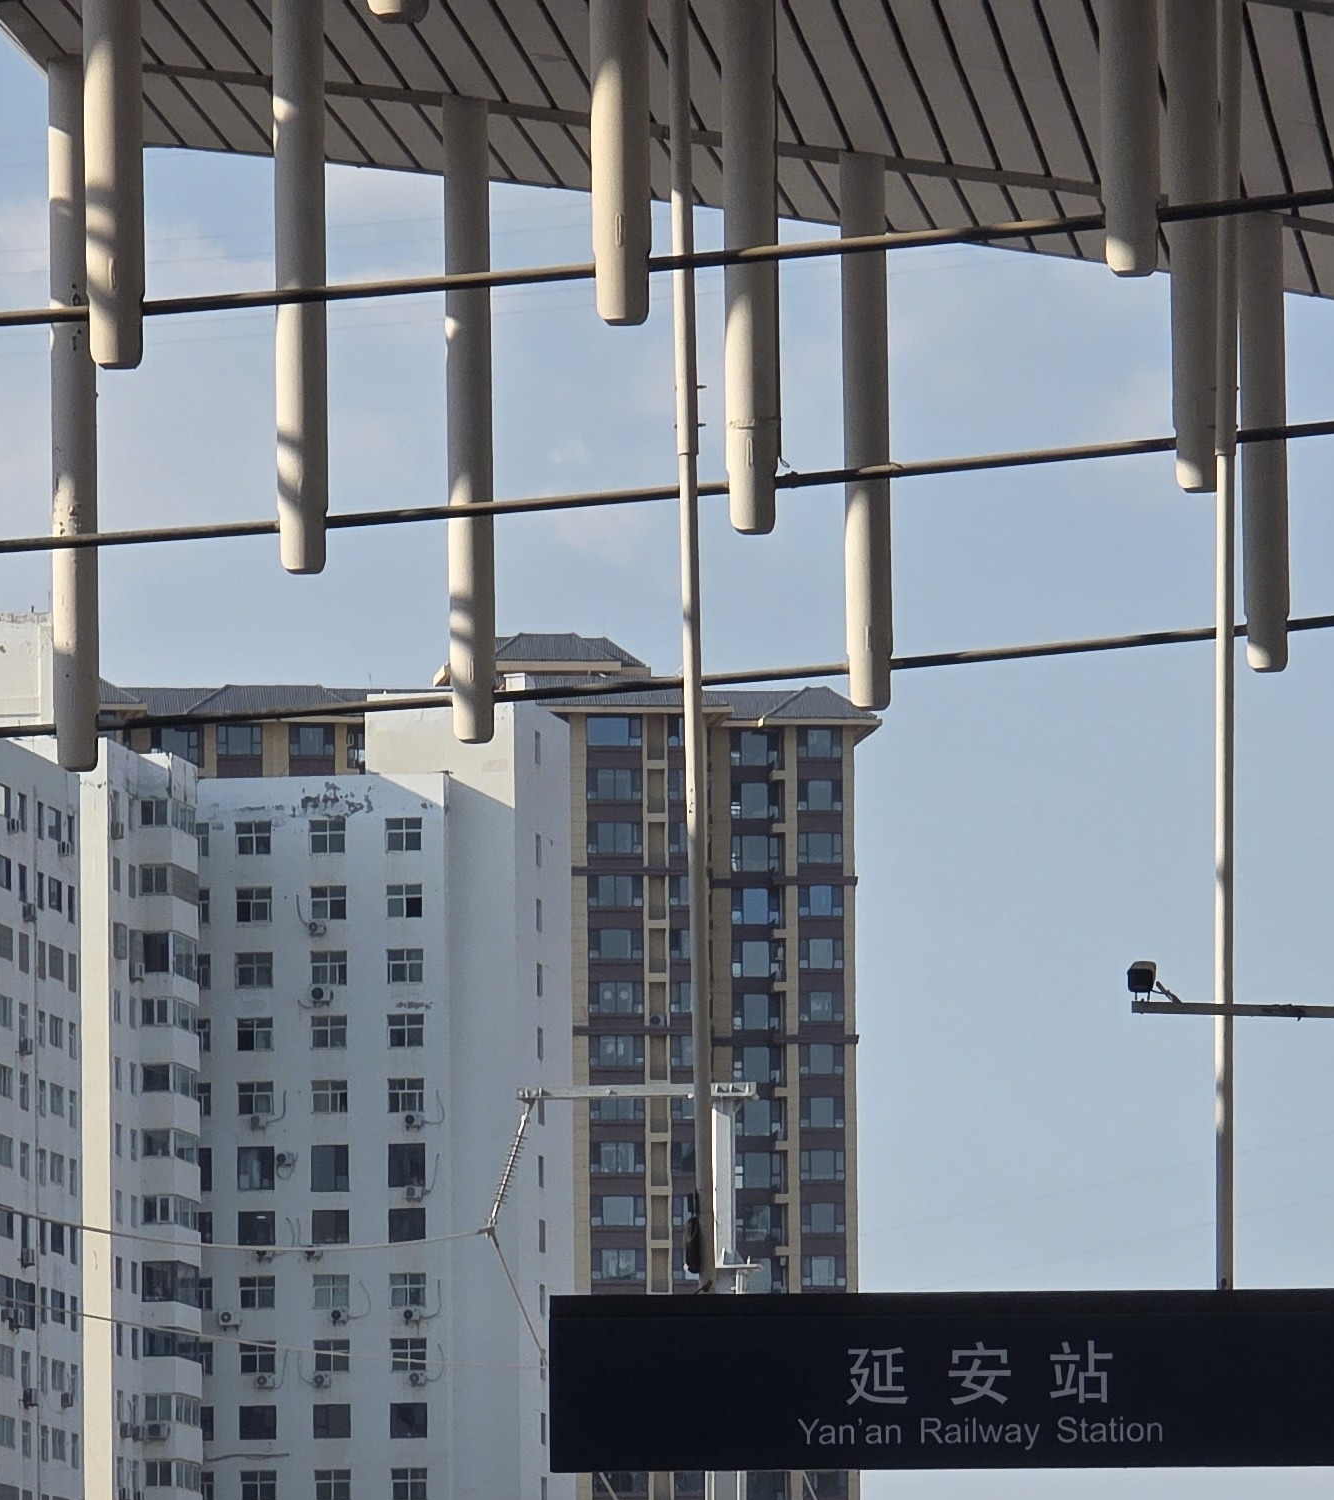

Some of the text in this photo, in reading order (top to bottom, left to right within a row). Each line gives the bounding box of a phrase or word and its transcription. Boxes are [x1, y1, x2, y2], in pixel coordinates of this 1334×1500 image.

[846, 1340, 1113, 1405] 延安站
[798, 1416, 1163, 1450] Yan'an Railway Station
